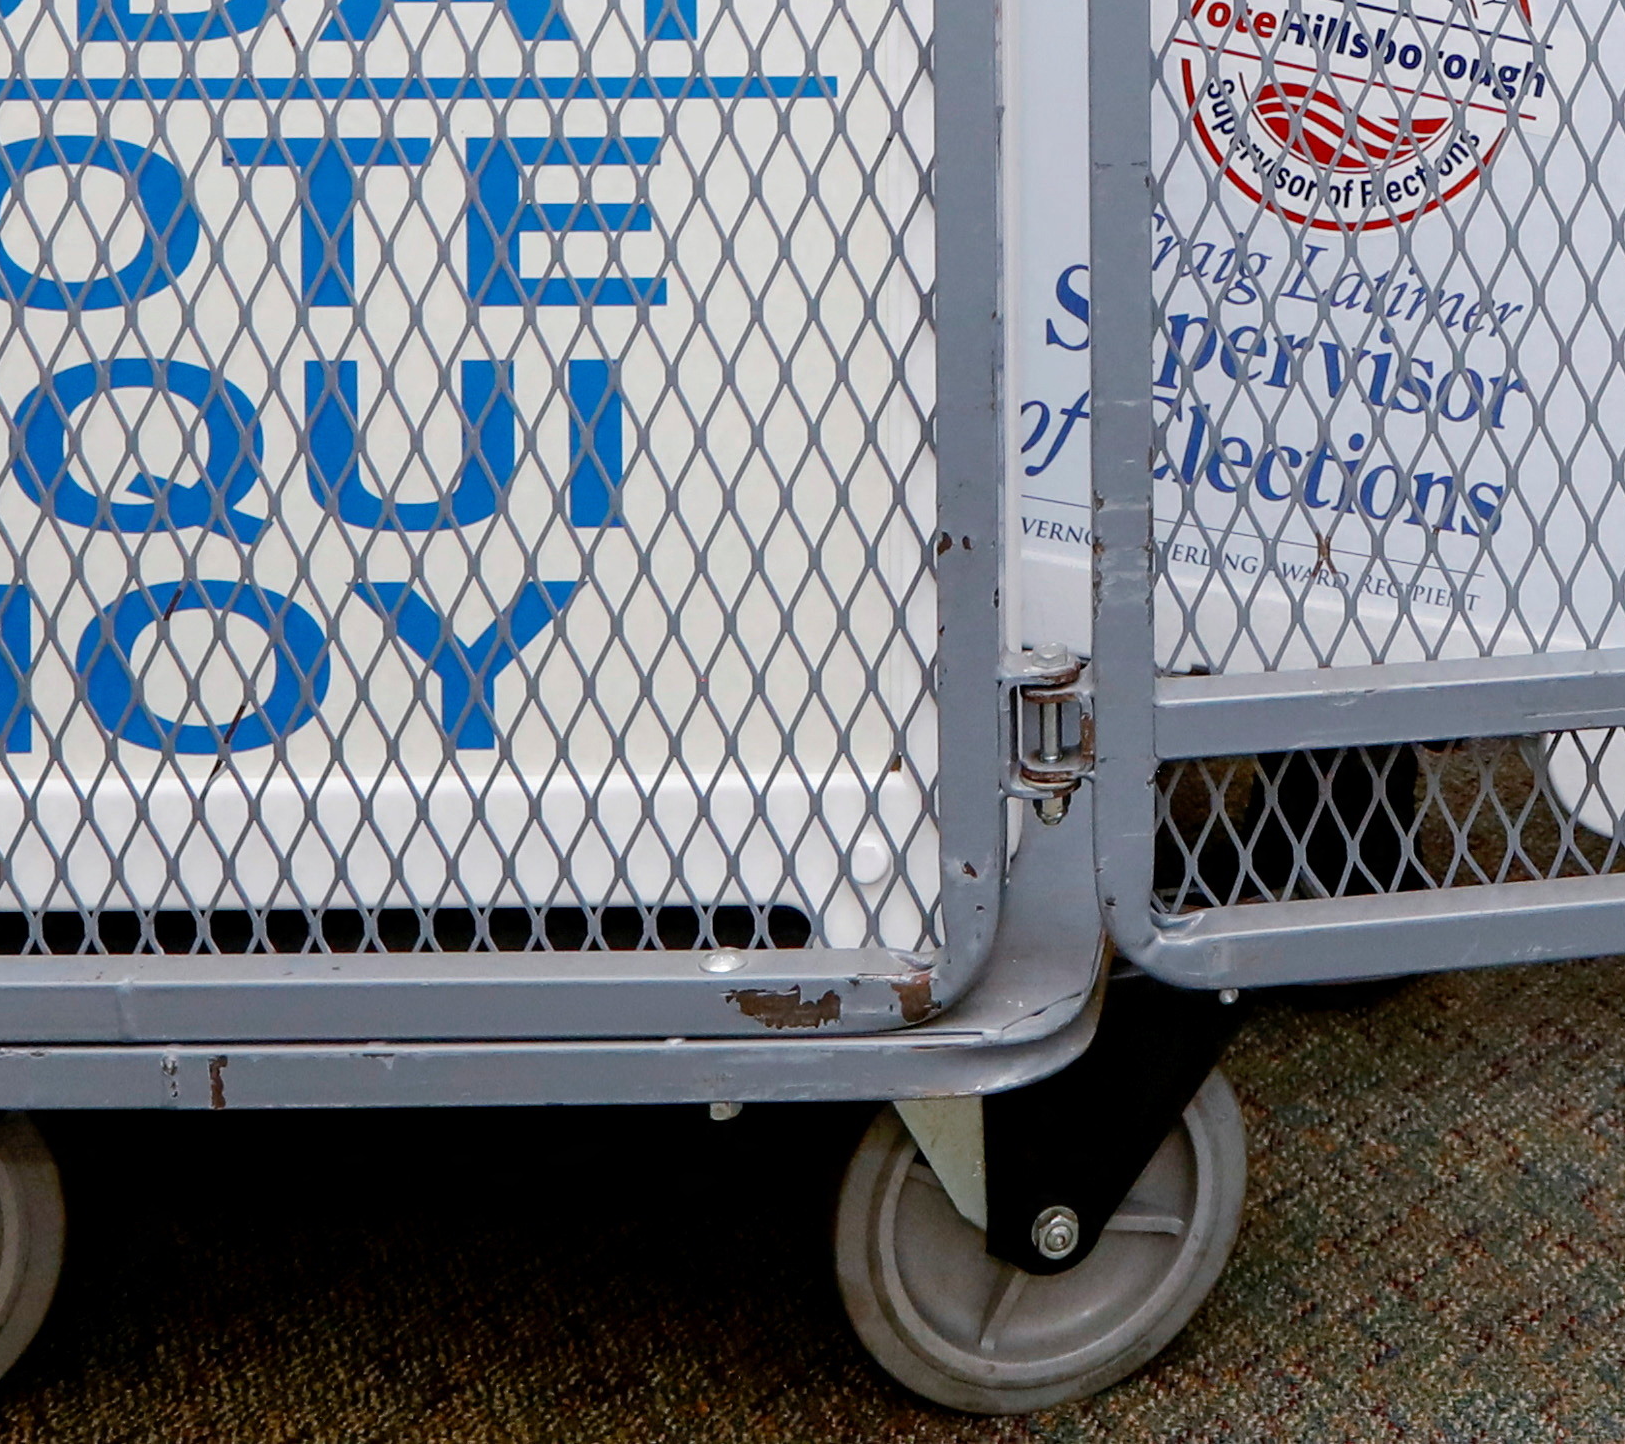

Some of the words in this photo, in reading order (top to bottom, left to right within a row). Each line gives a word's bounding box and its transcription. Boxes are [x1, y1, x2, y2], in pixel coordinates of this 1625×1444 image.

[1361, 130, 1480, 207] Eectons
[1152, 211, 1272, 305] raig
[1281, 243, 1523, 338] Latimer
[1046, 264, 1528, 430] Spervisor
